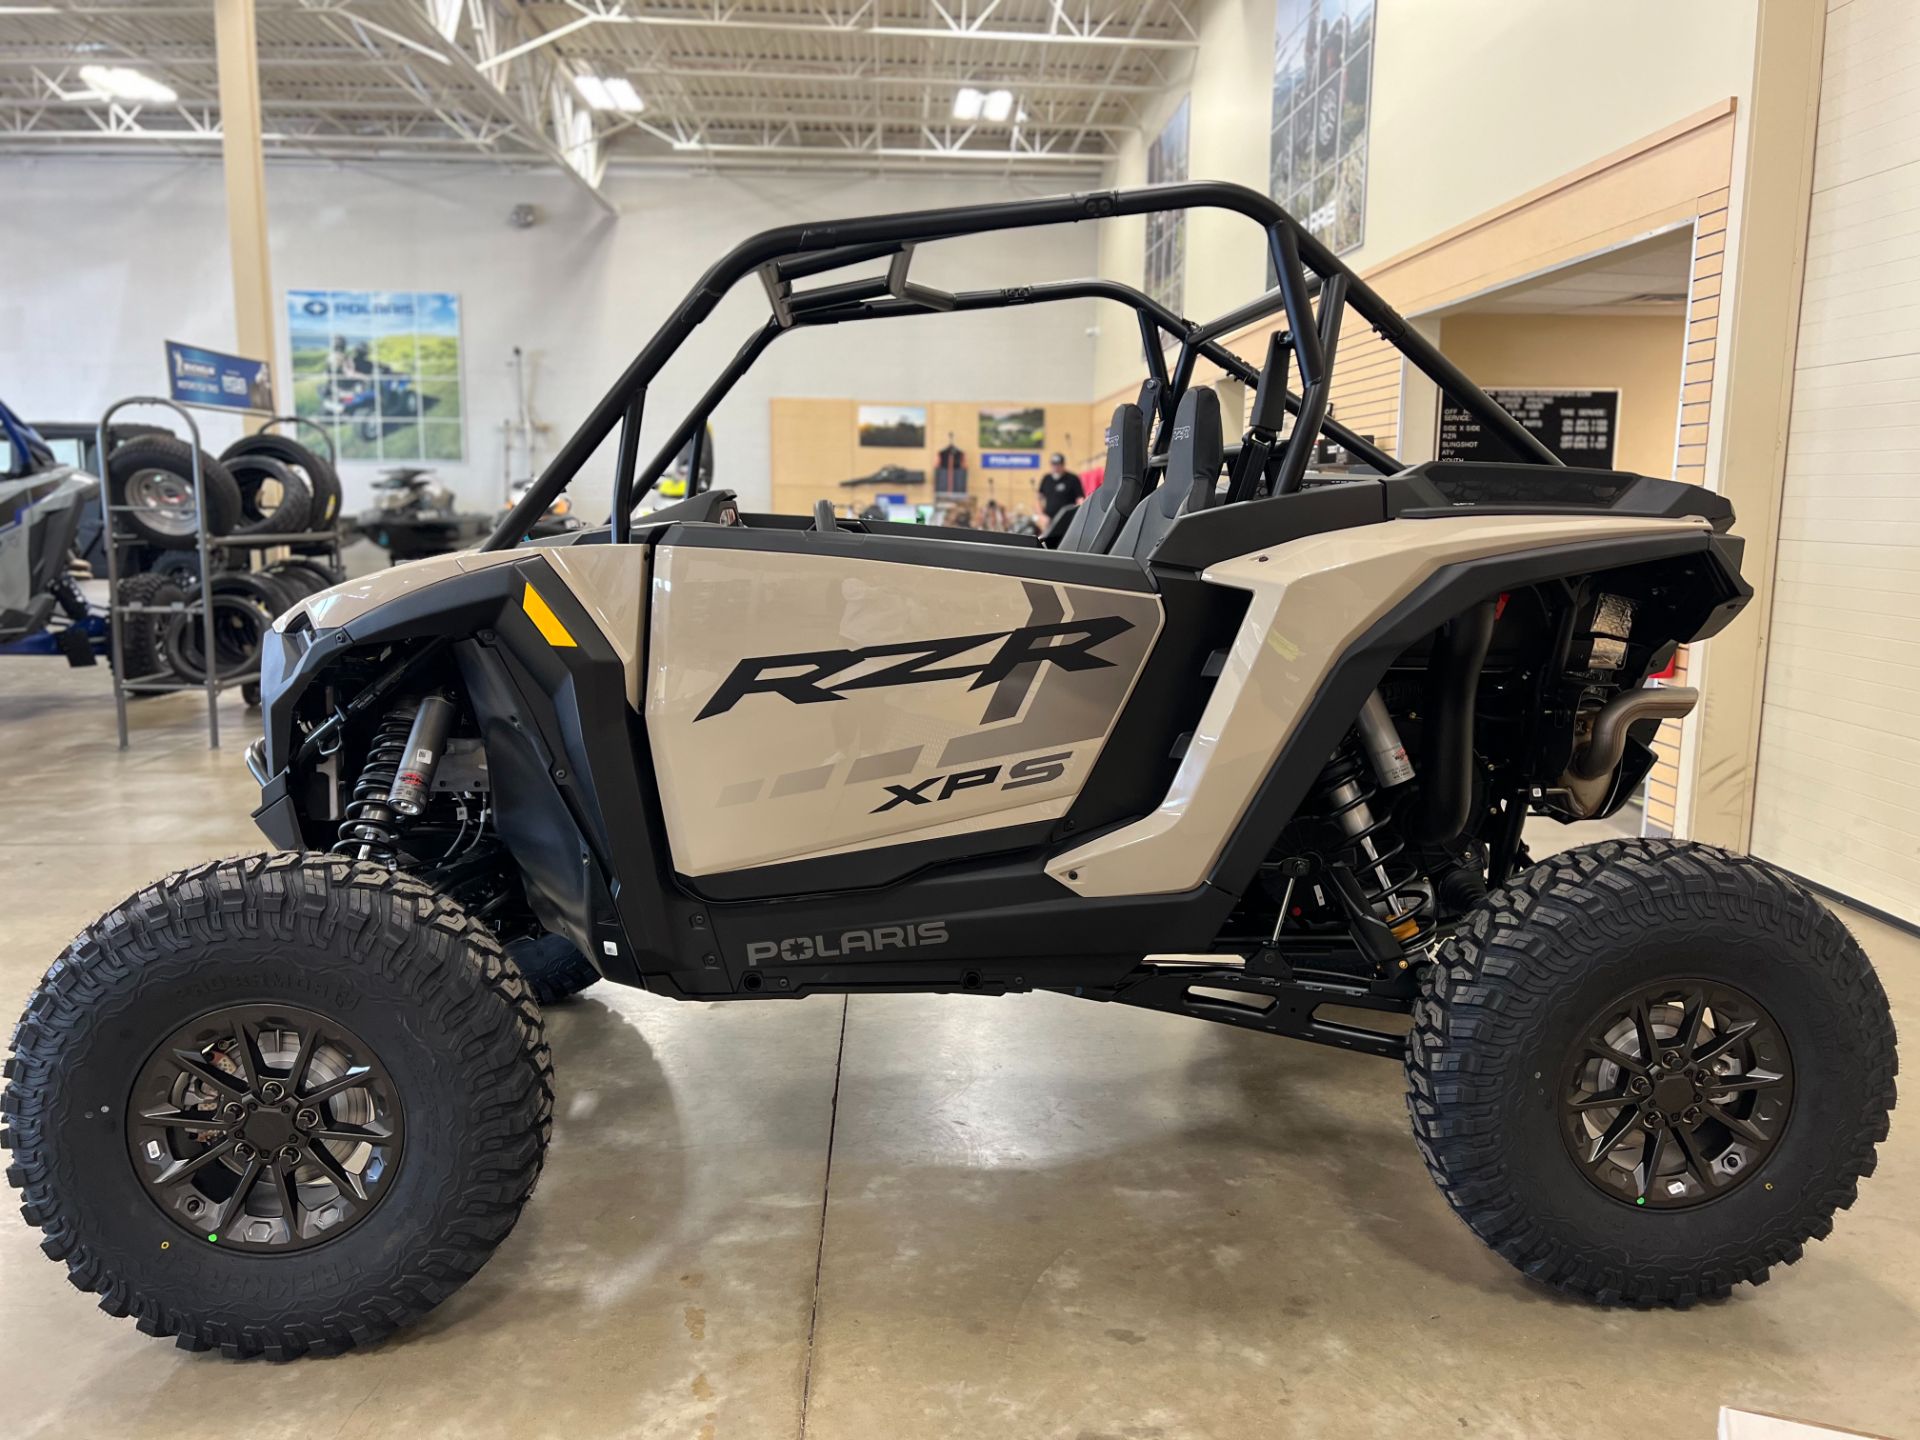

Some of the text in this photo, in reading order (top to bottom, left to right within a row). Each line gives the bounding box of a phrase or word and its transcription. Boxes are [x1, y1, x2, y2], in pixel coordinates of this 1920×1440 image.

[334, 302, 414, 315] POLARIS
[692, 615, 1136, 723] RZR
[868, 751, 1074, 814] XPS
[746, 921, 949, 966] POLARIS
